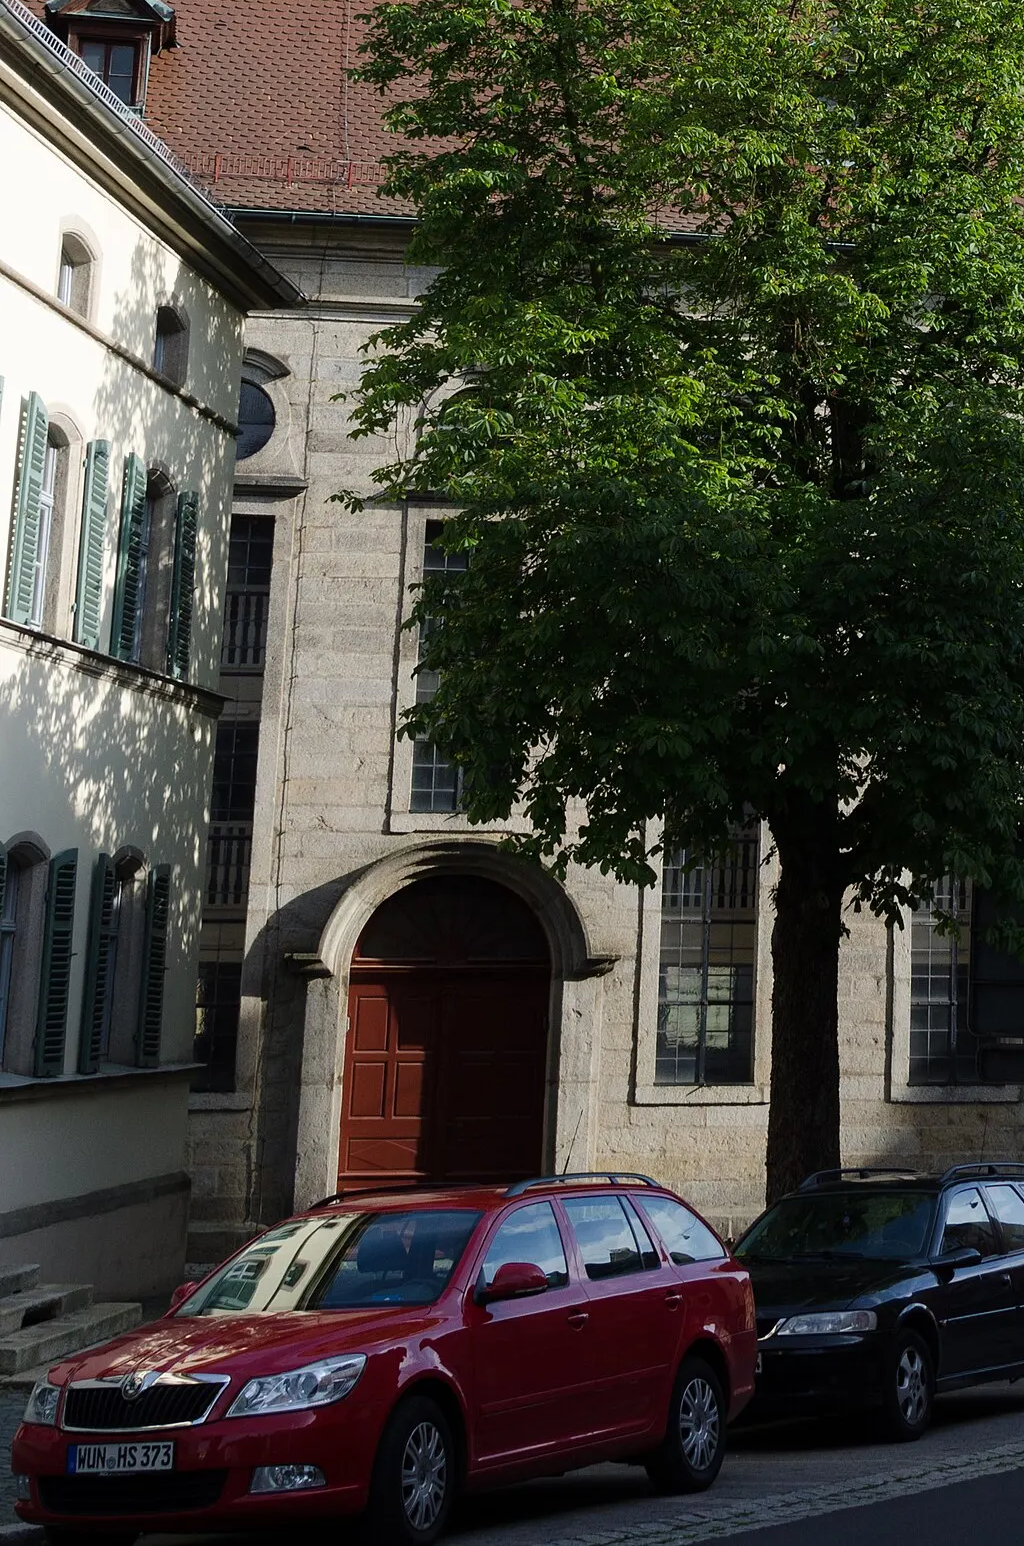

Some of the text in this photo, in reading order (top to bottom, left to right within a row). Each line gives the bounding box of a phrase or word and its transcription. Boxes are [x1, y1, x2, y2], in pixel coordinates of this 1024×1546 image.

[78, 1444, 171, 1470] WUN HS 373
